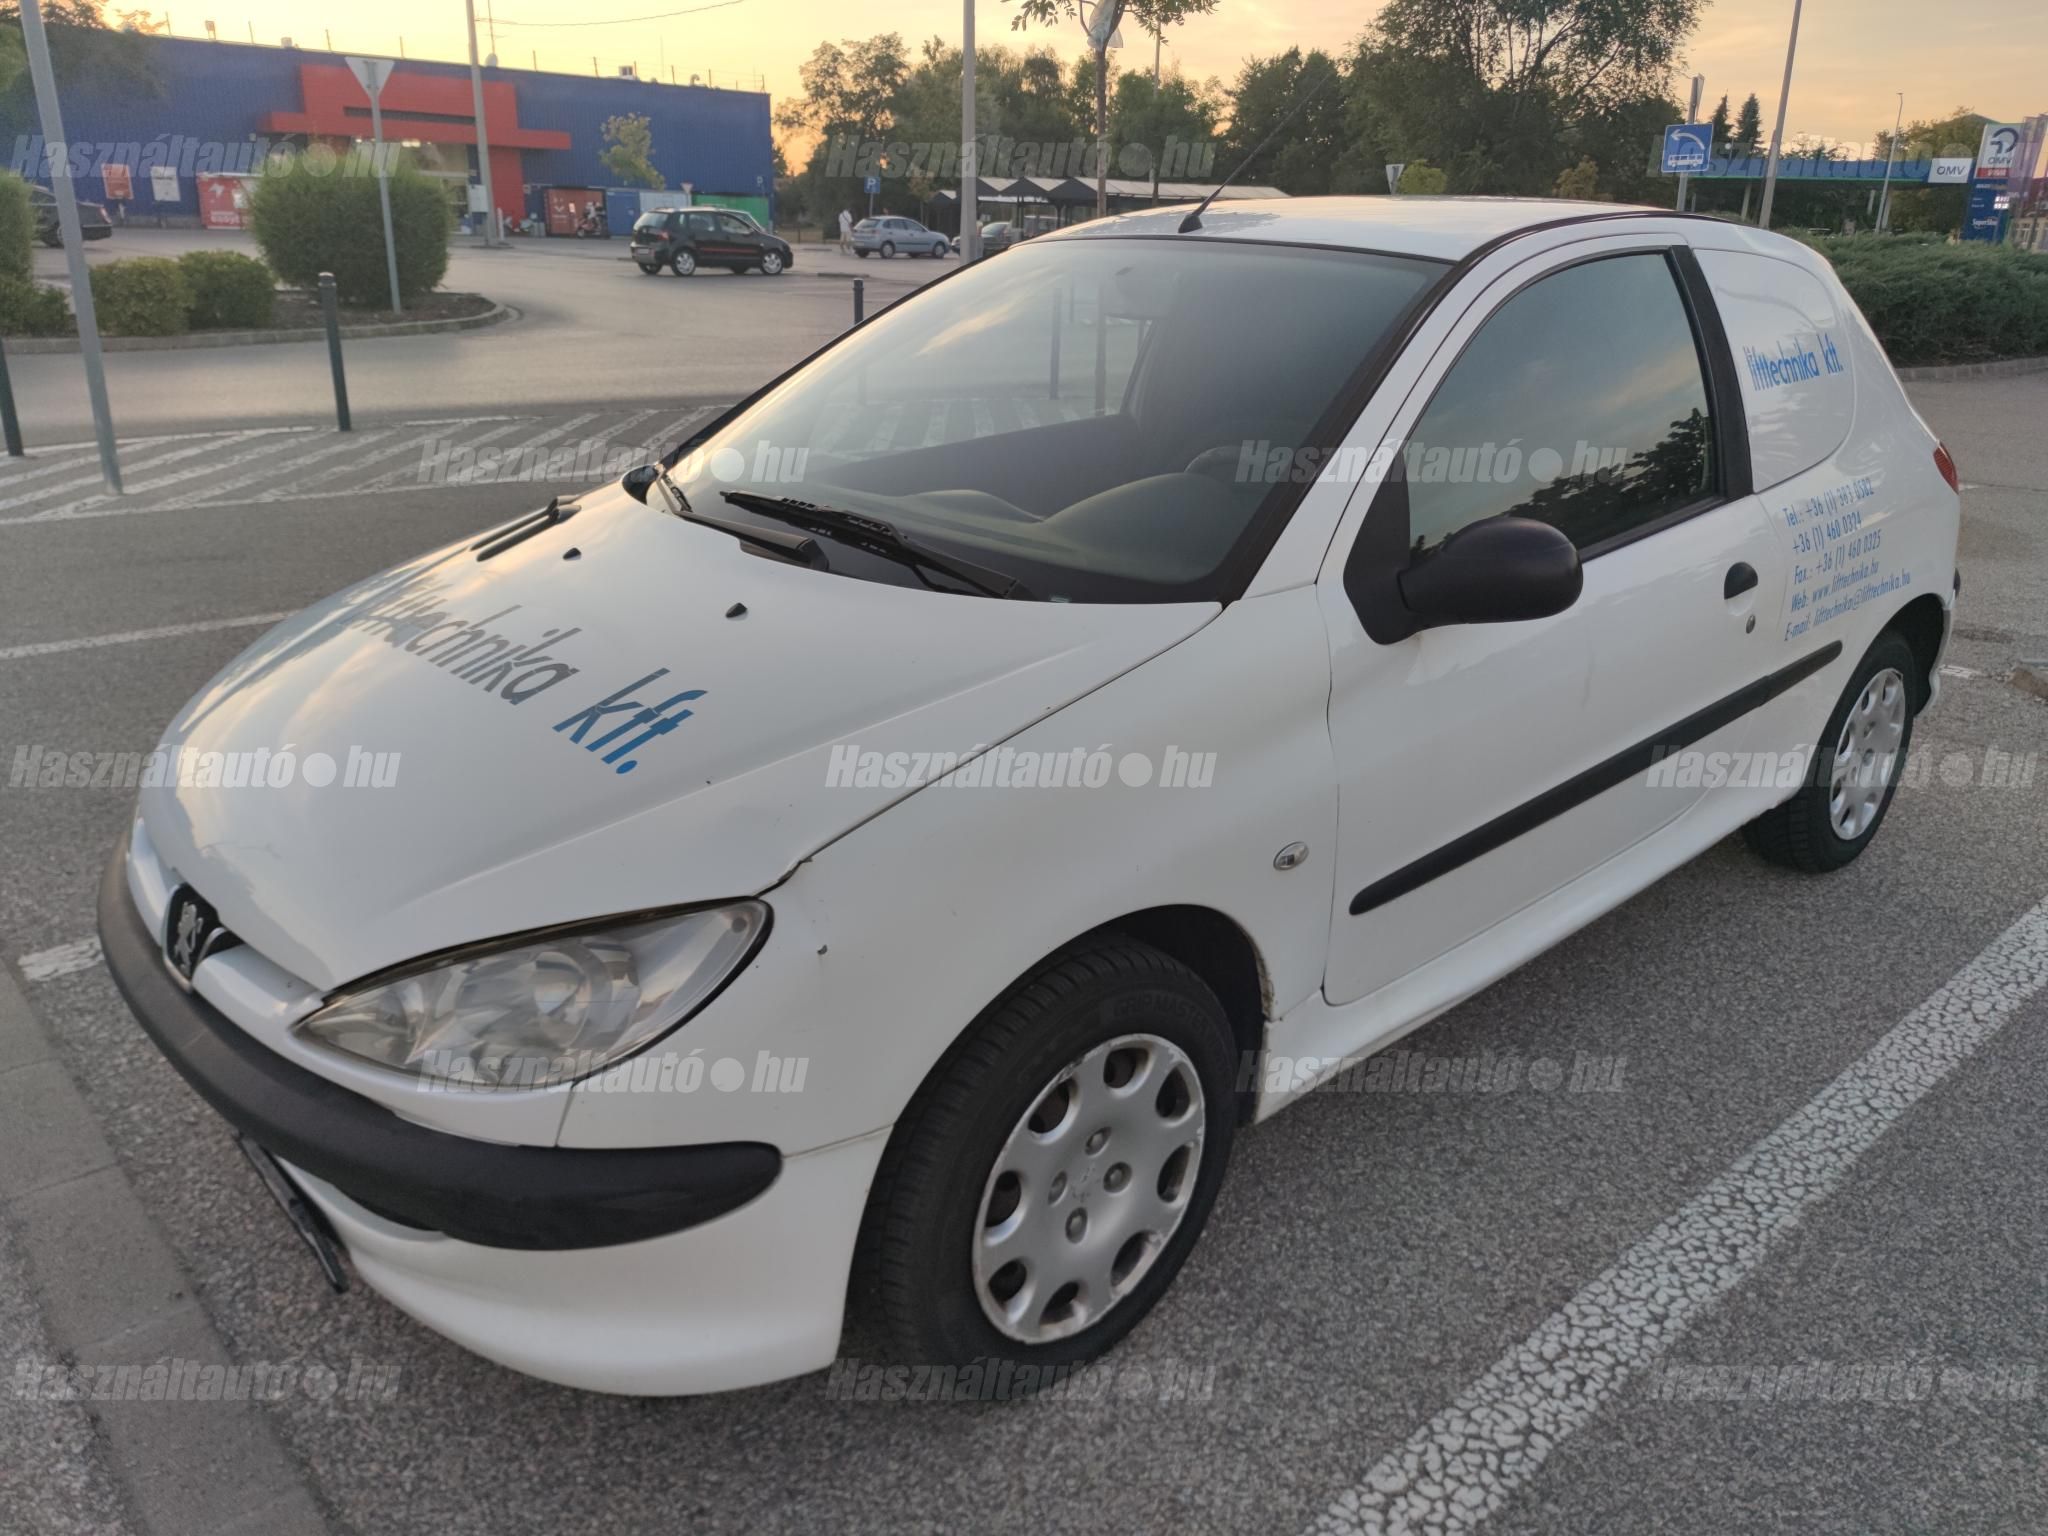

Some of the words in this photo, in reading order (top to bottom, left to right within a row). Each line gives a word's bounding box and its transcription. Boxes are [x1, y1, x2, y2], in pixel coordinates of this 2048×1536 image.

[1936, 166, 1966, 176] OMV
[866, 178, 877, 190] P
[1806, 496, 1824, 518] +36
[1793, 531, 1811, 553] +36
[1812, 525, 1825, 552] (1)
[1826, 519, 1841, 541] 460
[1816, 552, 1832, 575] +36
[1848, 538, 1862, 561] 460
[1791, 589, 1809, 612] Web:
[551, 667, 708, 775] kft.
